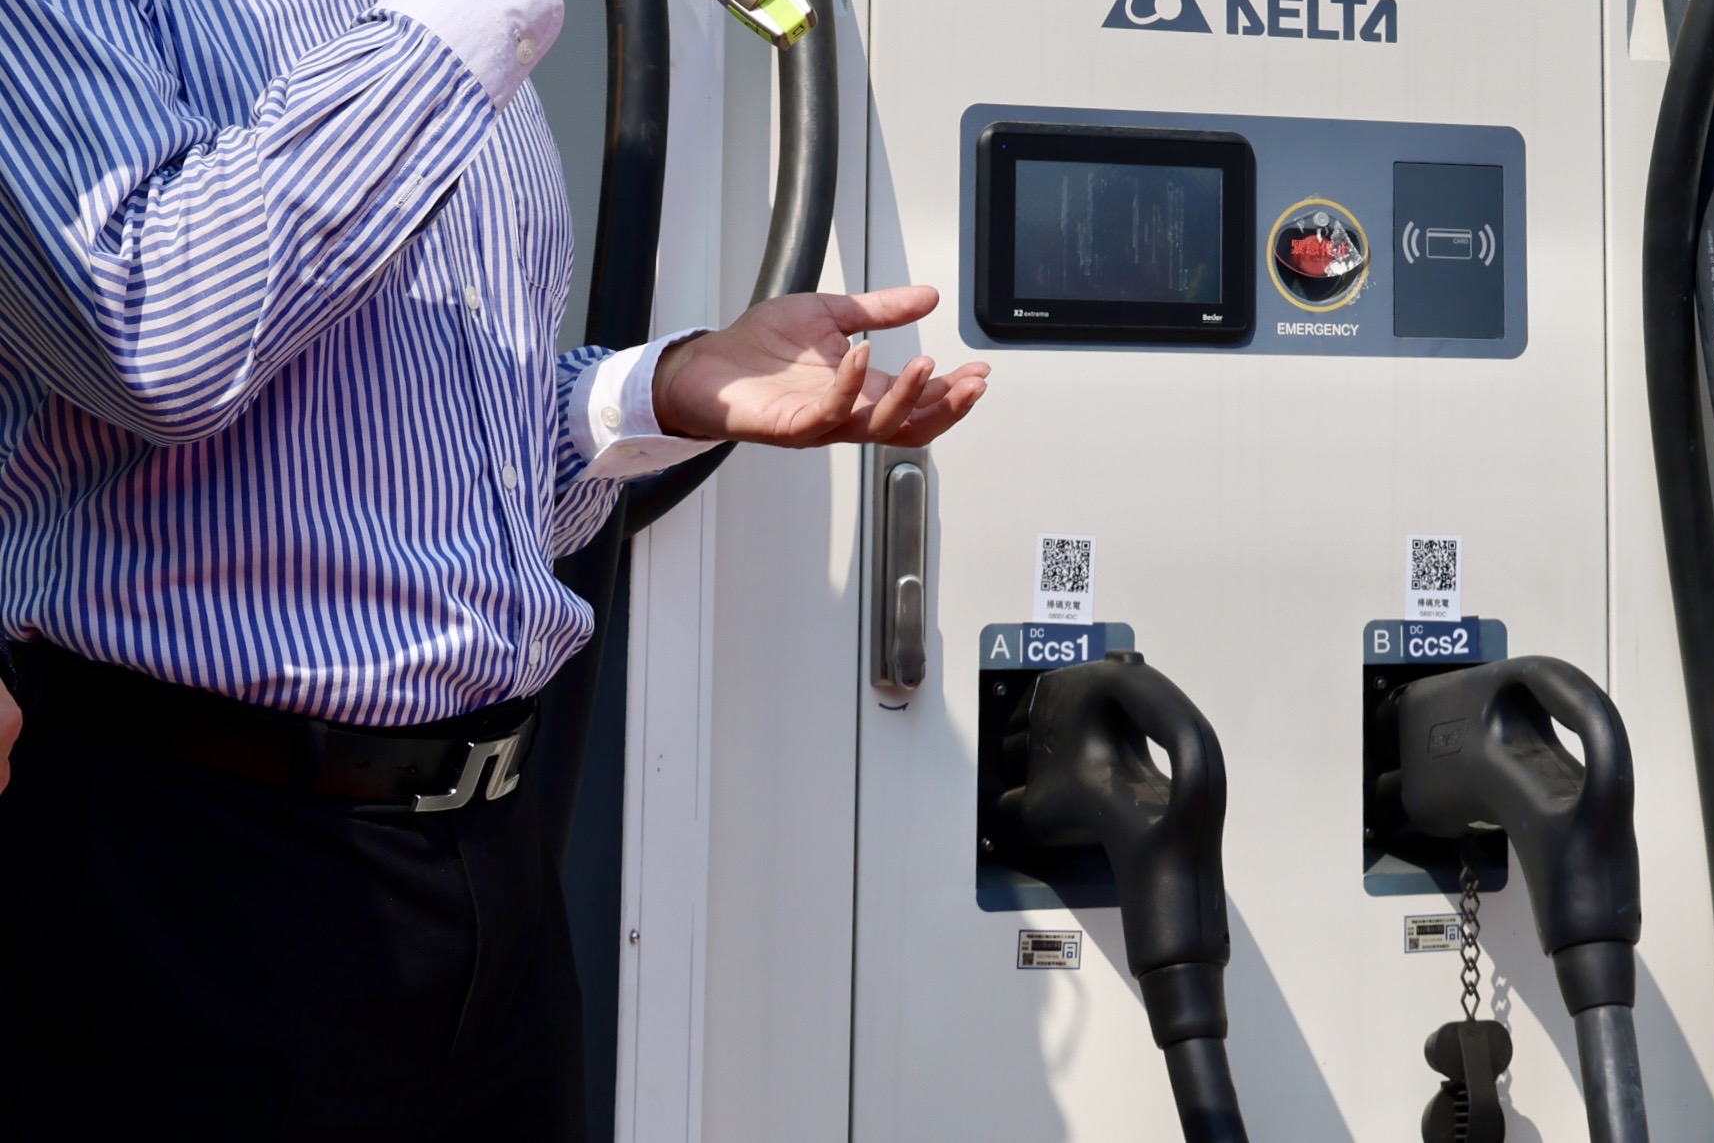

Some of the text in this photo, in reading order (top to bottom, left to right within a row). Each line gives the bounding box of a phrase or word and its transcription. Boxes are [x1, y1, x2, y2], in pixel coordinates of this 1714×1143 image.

[1013, 309, 1023, 317] X2
[1277, 322, 1360, 336] EMERGENCY
[1046, 599, 1081, 611] 掃碼充電
[1417, 598, 1449, 608] 掃碼充電
[1030, 627, 1045, 638] DC
[1409, 625, 1424, 635] DC
[990, 634, 1011, 659] A
[1027, 634, 1089, 662] CCS1
[1374, 629, 1391, 654] B
[1408, 628, 1470, 657] CCS2
